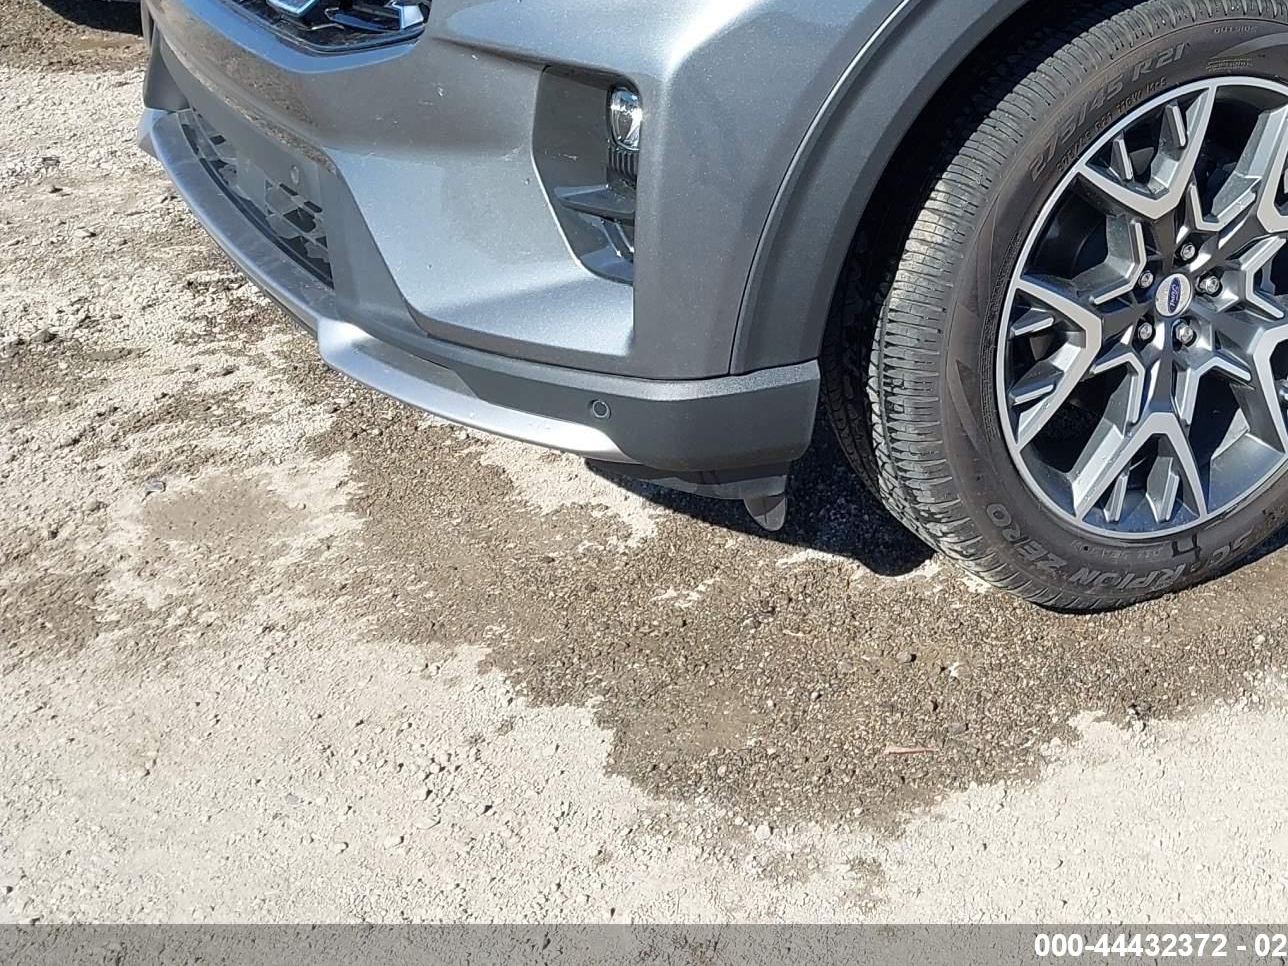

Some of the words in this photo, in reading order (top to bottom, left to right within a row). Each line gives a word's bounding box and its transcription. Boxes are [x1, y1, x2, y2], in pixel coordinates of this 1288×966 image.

[1028, 72, 1124, 181] 275/45
[1131, 42, 1186, 81] R21
[985, 502, 1069, 574] ZERO
